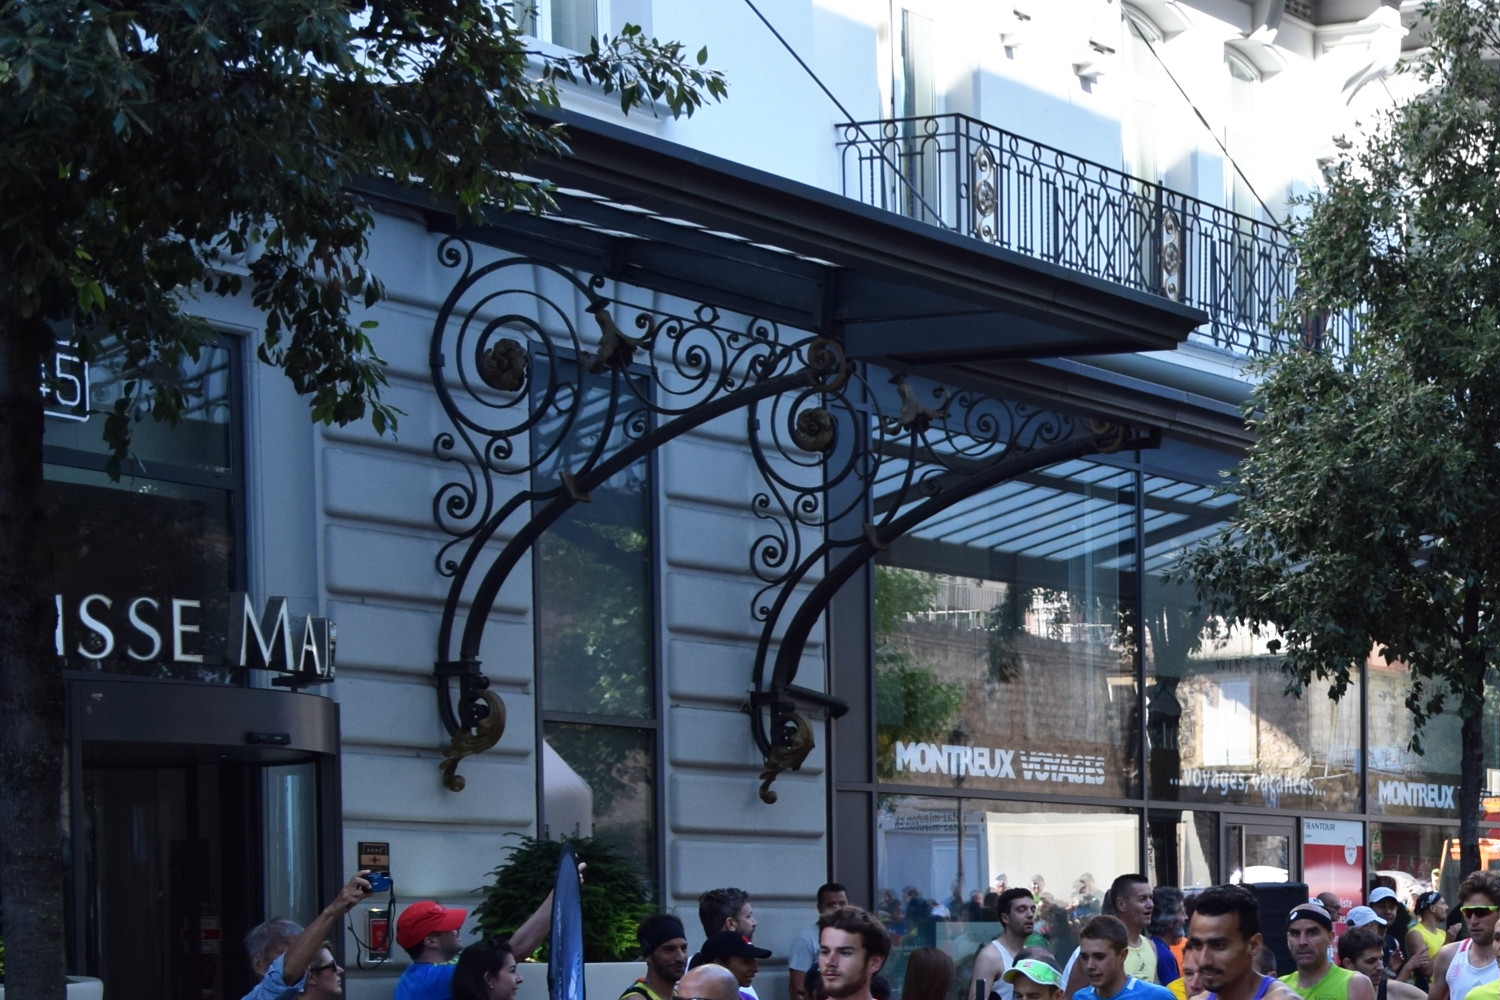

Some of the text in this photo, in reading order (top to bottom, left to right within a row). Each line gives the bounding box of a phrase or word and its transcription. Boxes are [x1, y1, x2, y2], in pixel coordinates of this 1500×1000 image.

[896, 740, 1105, 785] MONTREUX VOYAGES
[1379, 780, 1456, 809] MONTREUX
